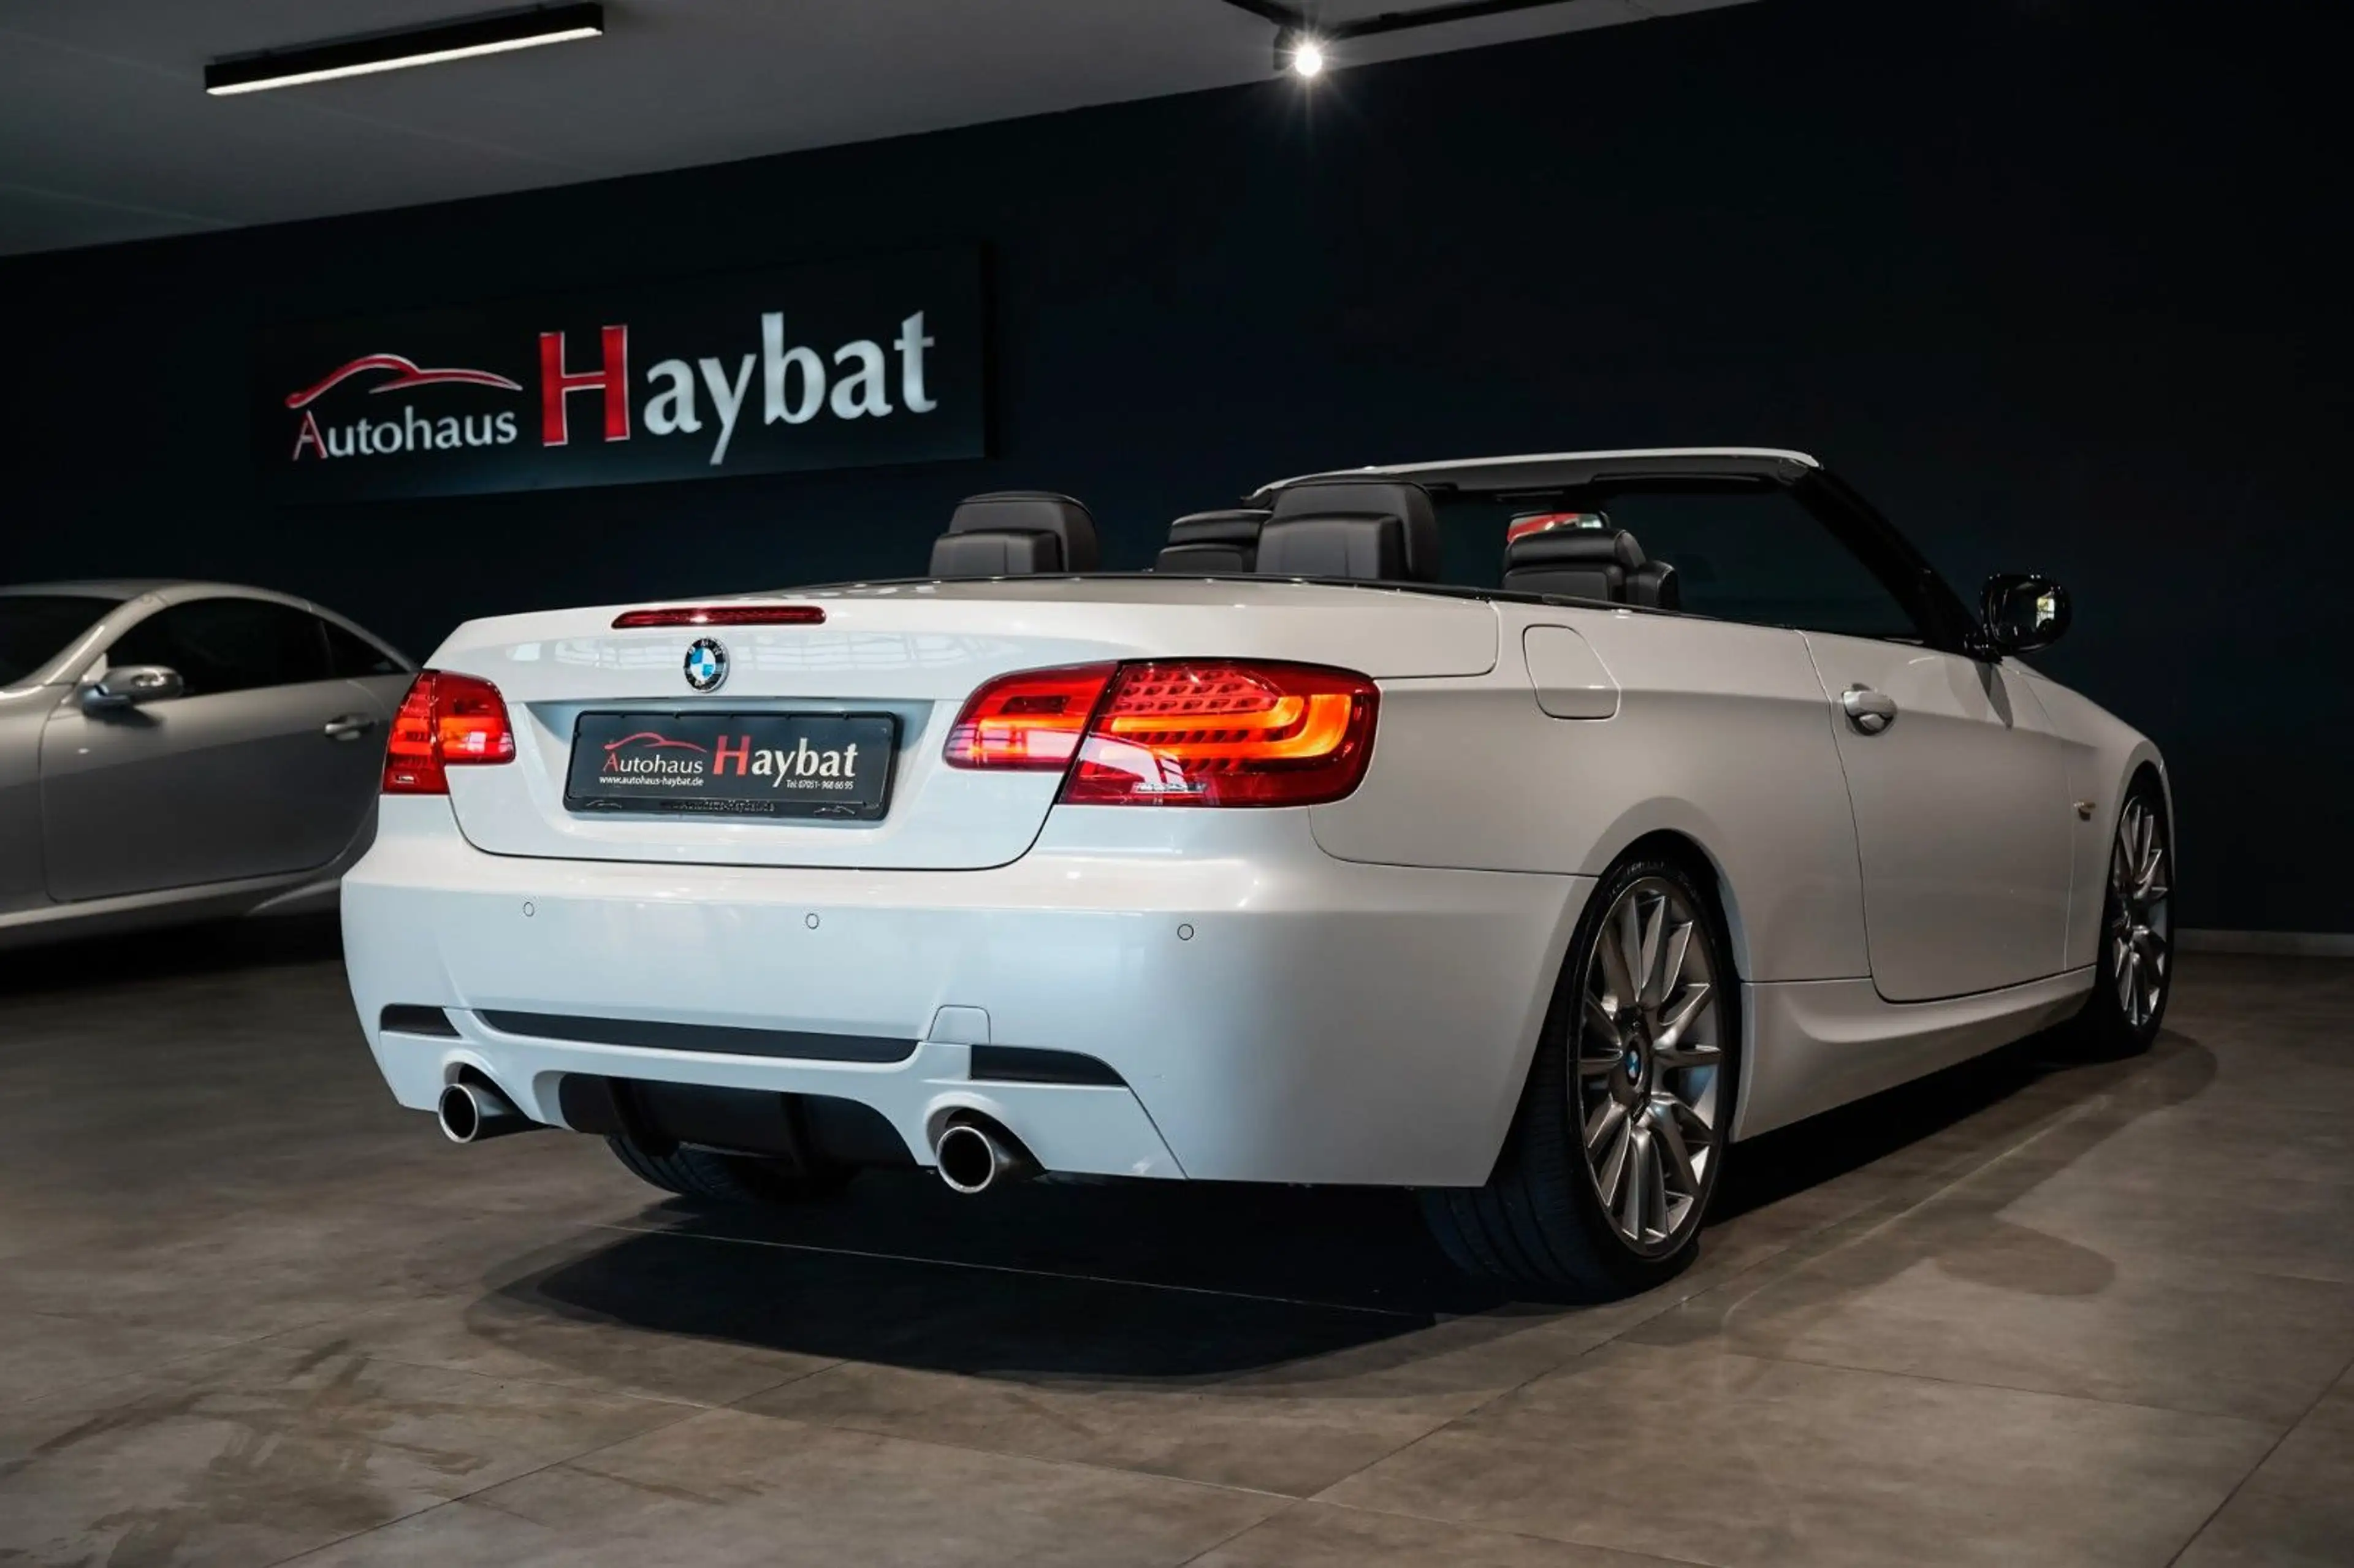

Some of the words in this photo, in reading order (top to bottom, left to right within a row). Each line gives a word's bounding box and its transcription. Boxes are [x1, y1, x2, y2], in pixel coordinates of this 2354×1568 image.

[292, 405, 518, 461] Autohaus
[538, 310, 938, 466] Haybat
[599, 775, 704, 787] www.autohaus-haybat.de
[603, 752, 704, 774] Autohaus
[712, 736, 858, 788] Haybat
